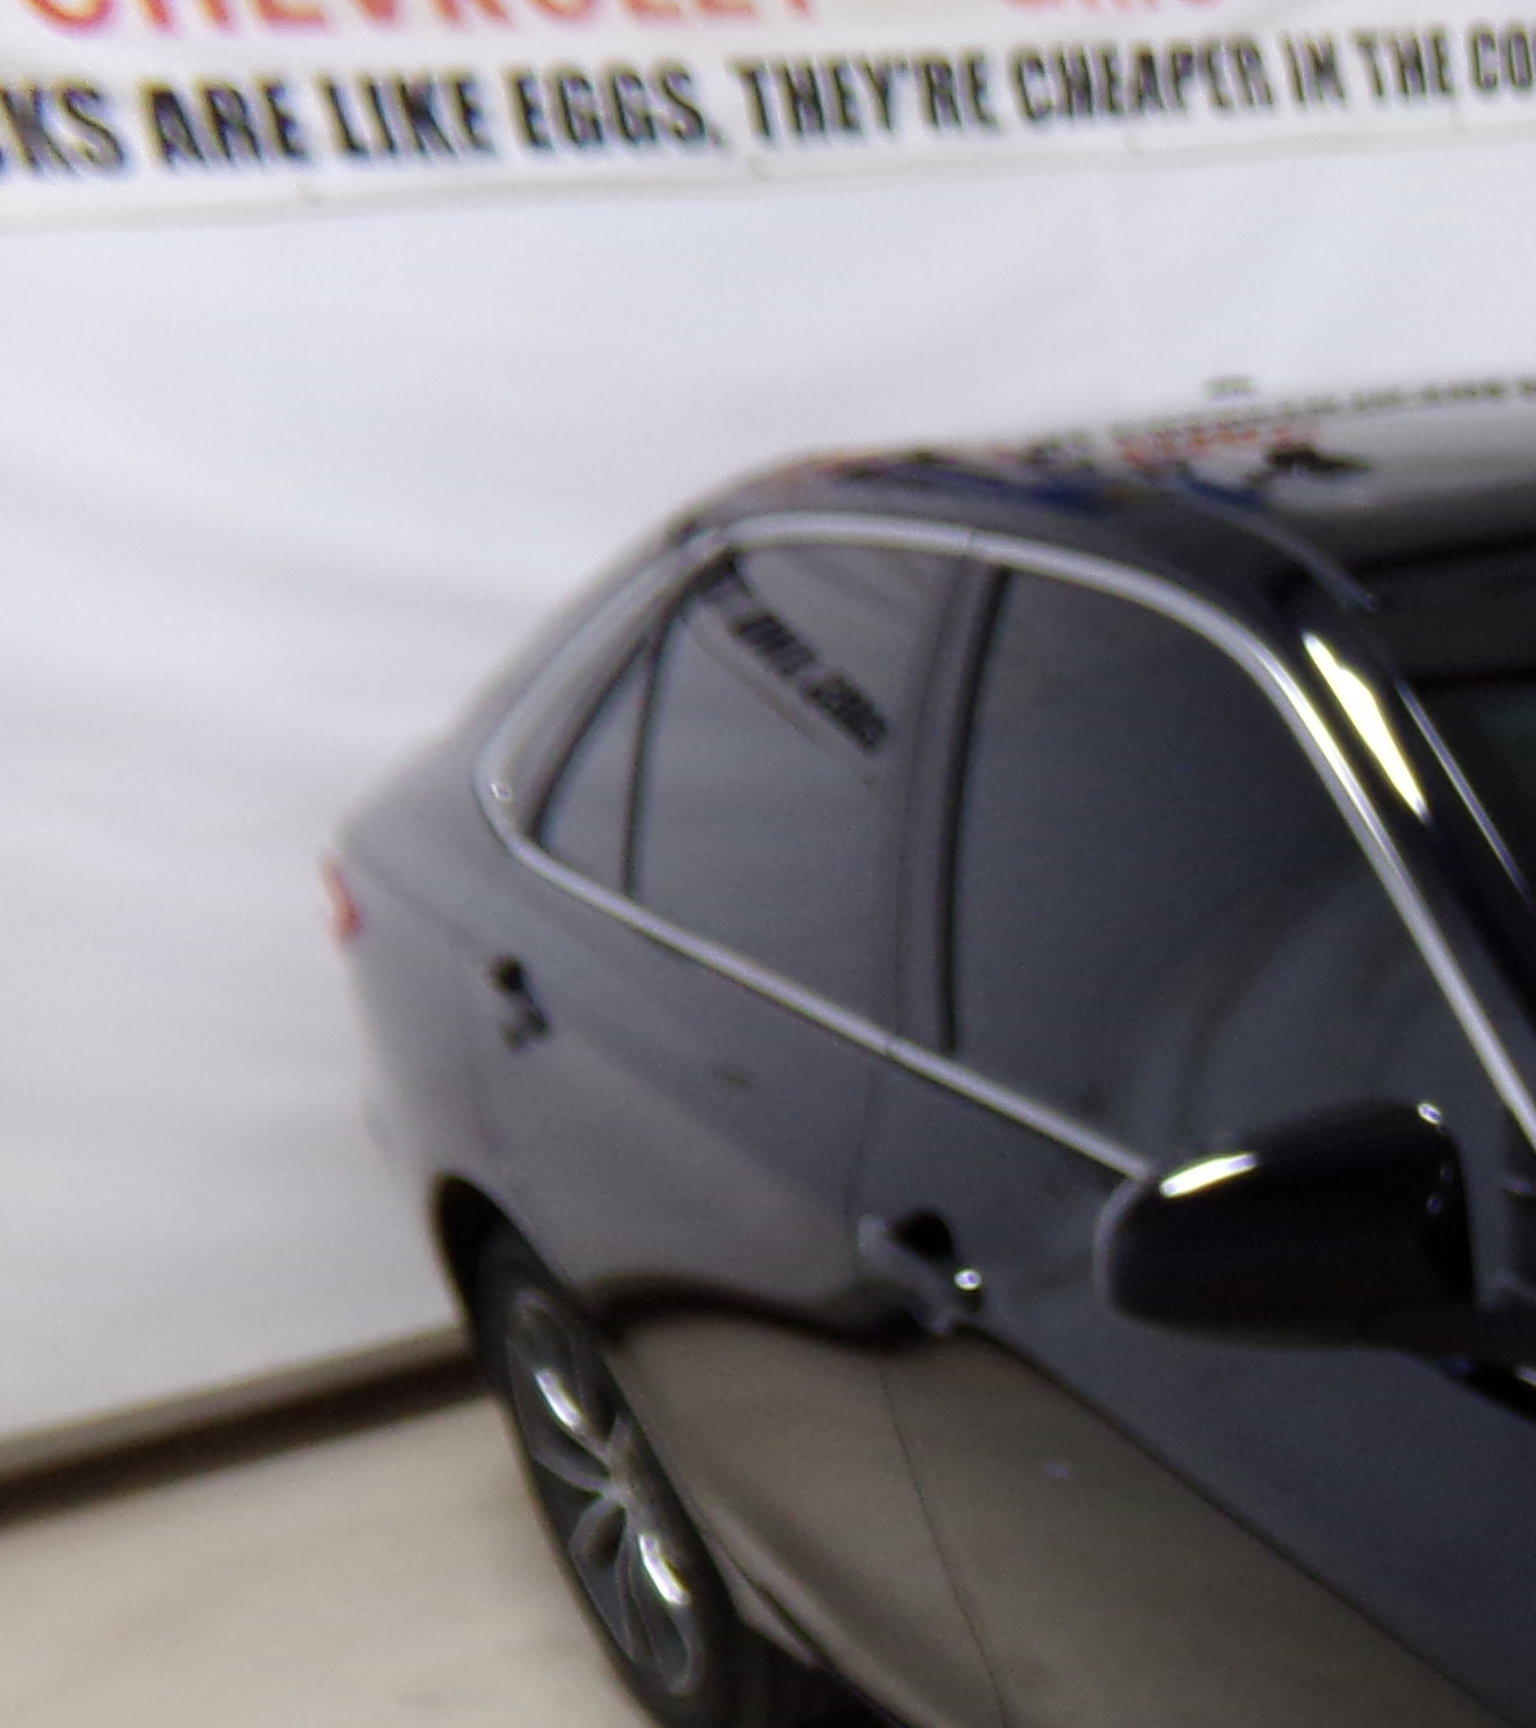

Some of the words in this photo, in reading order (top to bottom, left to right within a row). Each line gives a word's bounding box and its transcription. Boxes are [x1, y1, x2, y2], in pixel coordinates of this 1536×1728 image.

[0, 78, 129, 174] KS
[137, 76, 308, 166] ARE
[311, 66, 497, 161] LIKE
[728, 46, 1000, 140] THEY'RE
[1006, 36, 1275, 128] CHEAPER
[1283, 28, 1346, 108] IN
[1351, 24, 1453, 102] THE
